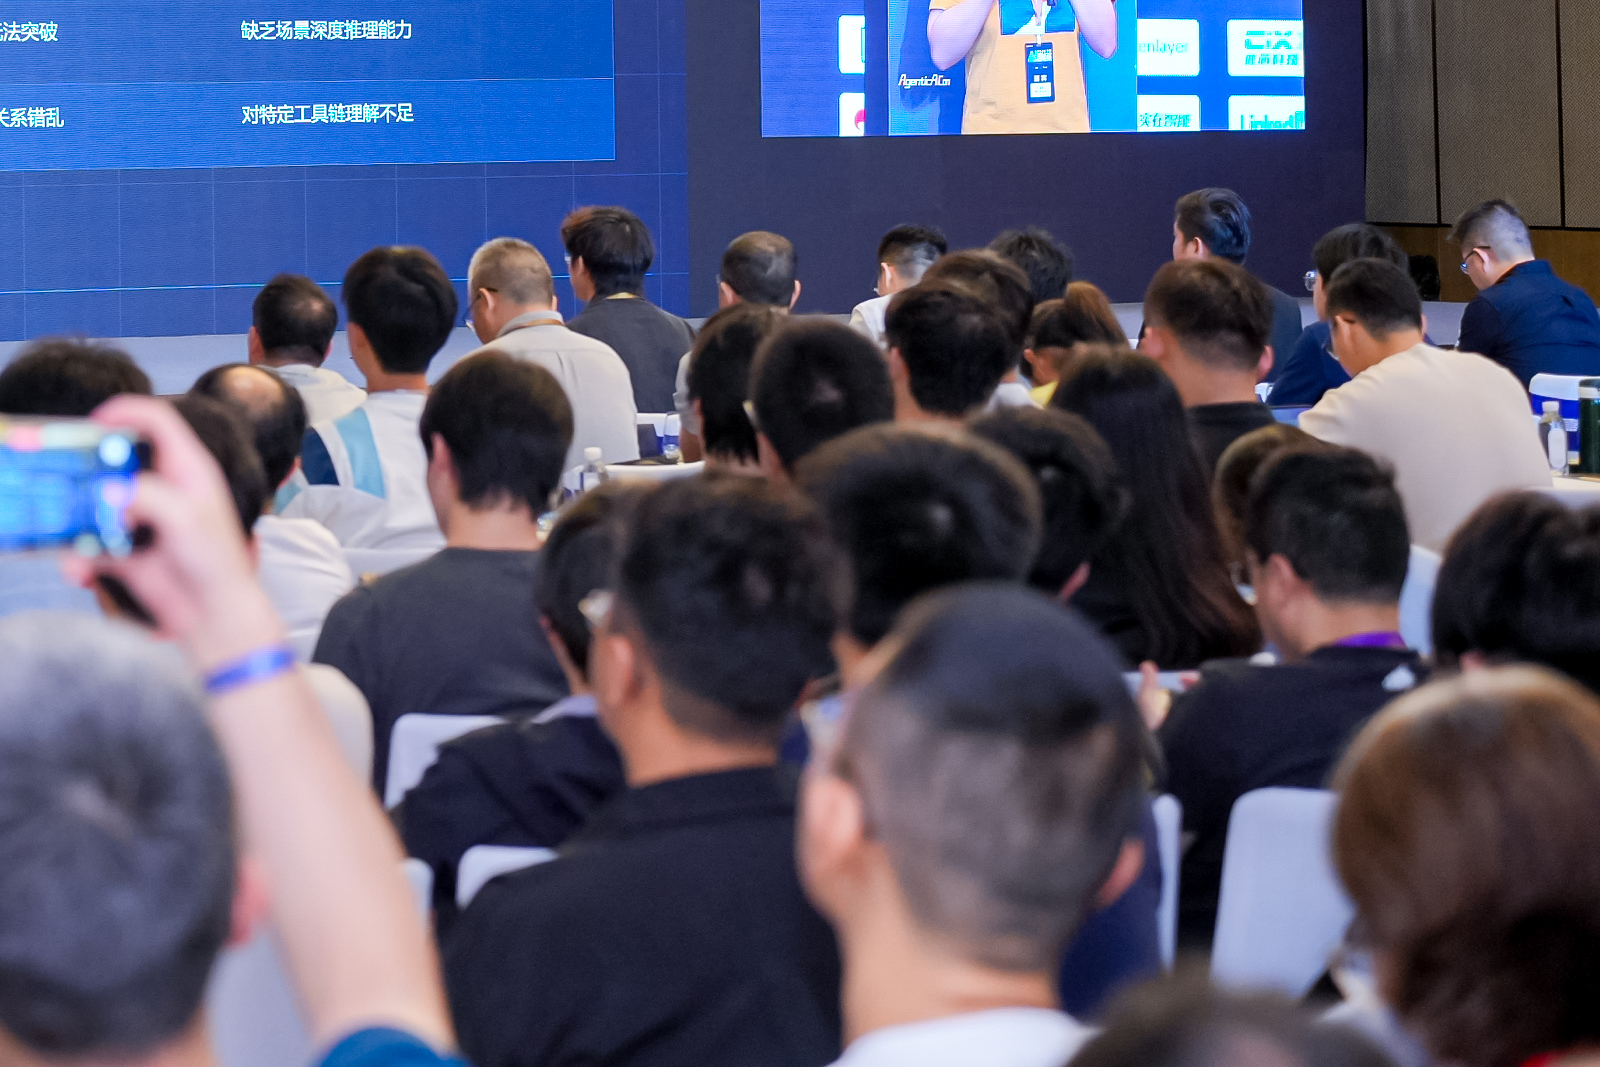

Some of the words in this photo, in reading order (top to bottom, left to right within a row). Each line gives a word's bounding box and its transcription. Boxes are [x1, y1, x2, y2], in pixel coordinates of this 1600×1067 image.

[240, 19, 412, 41] 缺乏场景深度推理能力
[1138, 39, 1189, 55] enlayer
[241, 102, 415, 125] 对特定工具链理解不足
